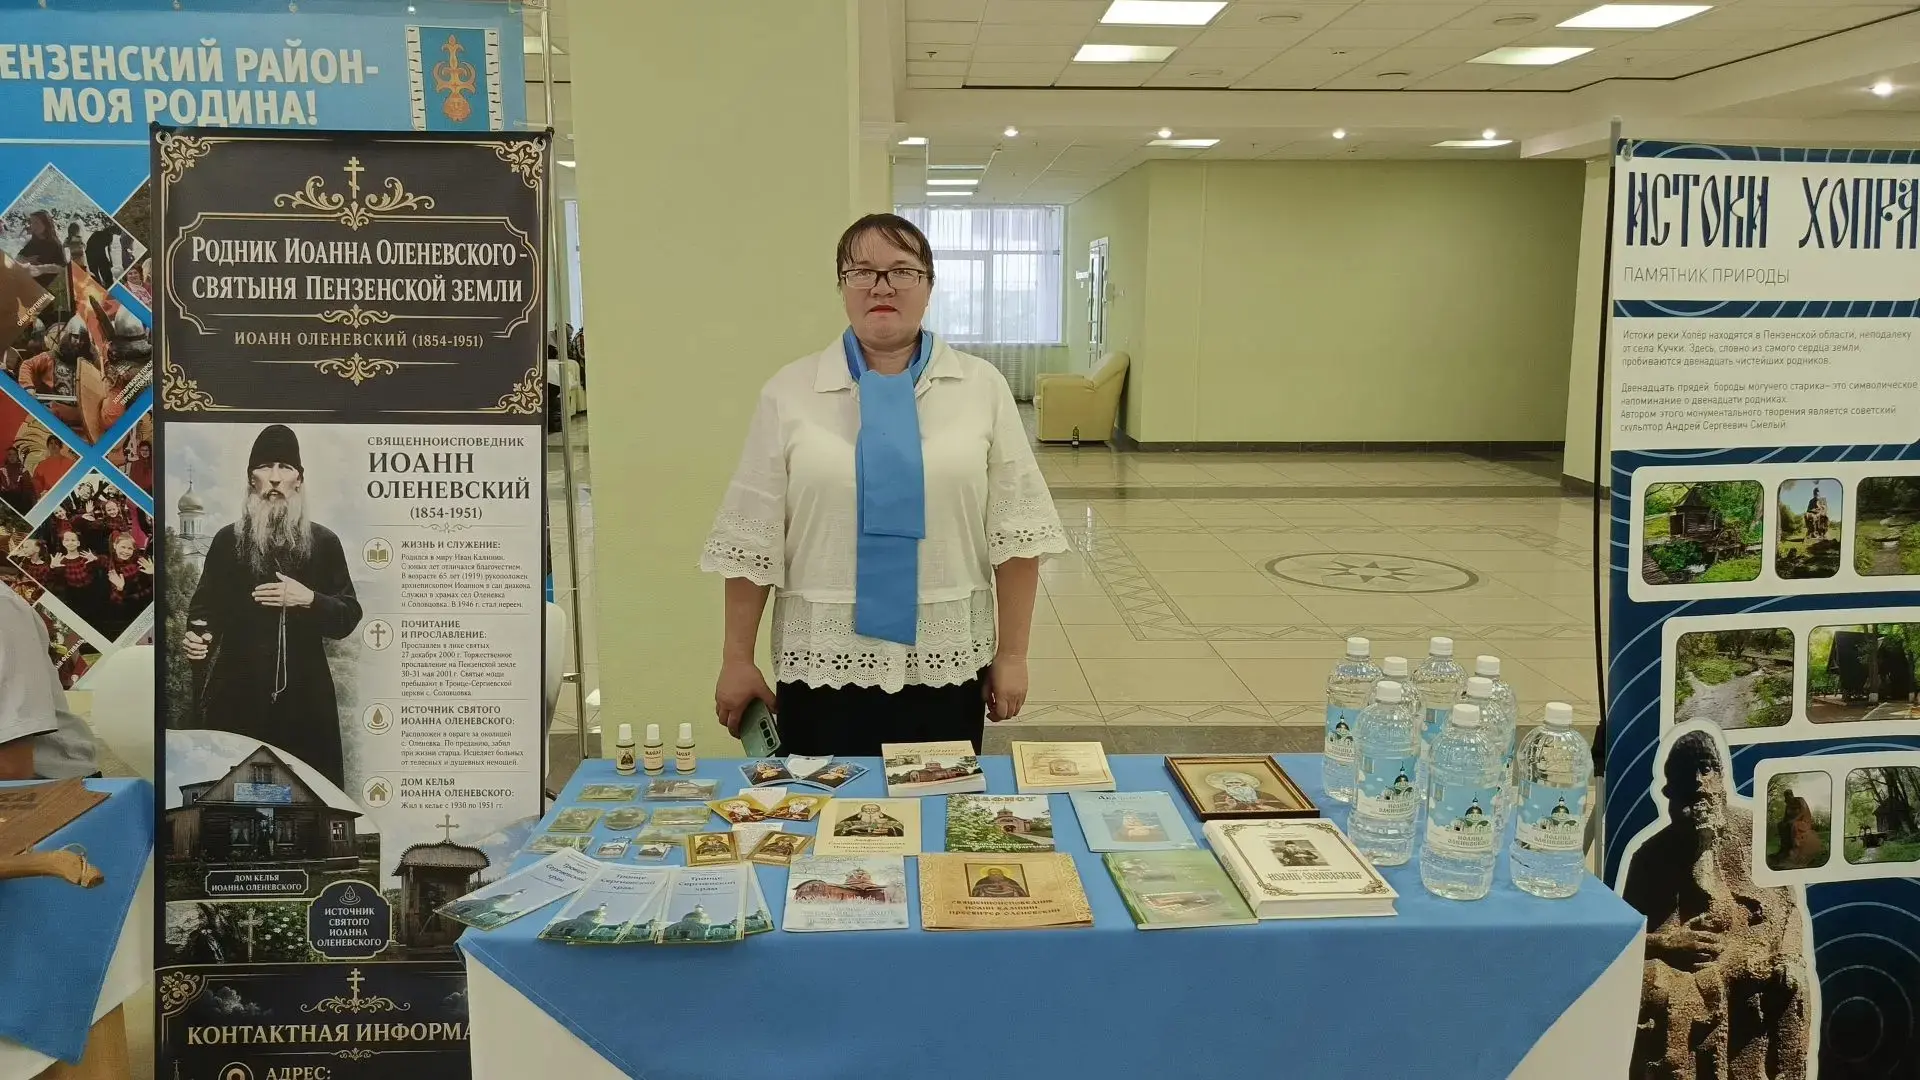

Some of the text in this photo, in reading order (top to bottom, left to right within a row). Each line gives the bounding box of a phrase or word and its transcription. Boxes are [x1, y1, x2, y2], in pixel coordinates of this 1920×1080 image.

[235, 38, 379, 84] РАЙОН-
[43, 87, 318, 127] МОЯ РОДИНА!
[1626, 171, 1919, 249] ИСТОКИ ХОПРА
[1624, 266, 1790, 286] ПАМЯТНИК ПРИРОДЫ
[192, 274, 523, 302] СВЯТЫНЯ ПЕНЗЕНСКОЙ ЗЕМЛИ
[234, 330, 484, 349] ИОАНН ОЛЕНЕВСКИЙ (1854-1951)
[1623, 330, 1654, 339] Истоки
[1657, 332, 1679, 341] реки
[1709, 332, 1753, 340] находятся
[1764, 329, 1816, 339] Пензенской
[1819, 330, 1857, 339] области,
[1765, 344, 1795, 352] самого
[1798, 344, 1829, 353] сердца
[1832, 344, 1862, 352] земли,
[1622, 357, 1681, 367] пробиваются
[1736, 357, 1784, 365] чистейших
[1621, 382, 1674, 393] Двенадцать
[1677, 382, 1709, 392] прядей
[1713, 381, 1745, 391] бороды
[1748, 383, 1788, 392] могучего
[1832, 382, 1846, 390] это
[1849, 381, 1918, 390] символическое
[1691, 397, 1742, 405] двенадцати
[1621, 410, 1656, 420] Автором
[1686, 409, 1762, 418] монументального
[1765, 408, 1806, 418] творения
[1808, 407, 1848, 416] является
[1851, 405, 1896, 415] советский
[1620, 421, 1748, 432] скульптор Андрей Сергеевич
[367, 436, 525, 447] СВЯЩЕННОИСПОВЕДНИК
[369, 452, 474, 474] ИОАНН
[367, 477, 531, 500] ОЛЕНЕВСКИЙ
[410, 506, 483, 520] (1854-1951)
[447, 541, 501, 549] СЛУЖЕНИЕ:
[401, 620, 460, 628] ПОЧИТАНИЕ
[401, 706, 454, 714] ИСТОЧНИК
[445, 717, 515, 725] ОЛЕНЕВСКОГО:
[401, 778, 423, 786] ДОМ
[401, 789, 514, 797] ИОАННА ОЛЕНЕВСКОГО:
[329, 918, 369, 926] СВЯТОГО
[187, 1024, 349, 1045] КОНТАКТНАЯ
[265, 1066, 331, 1080] АДРЕС:
